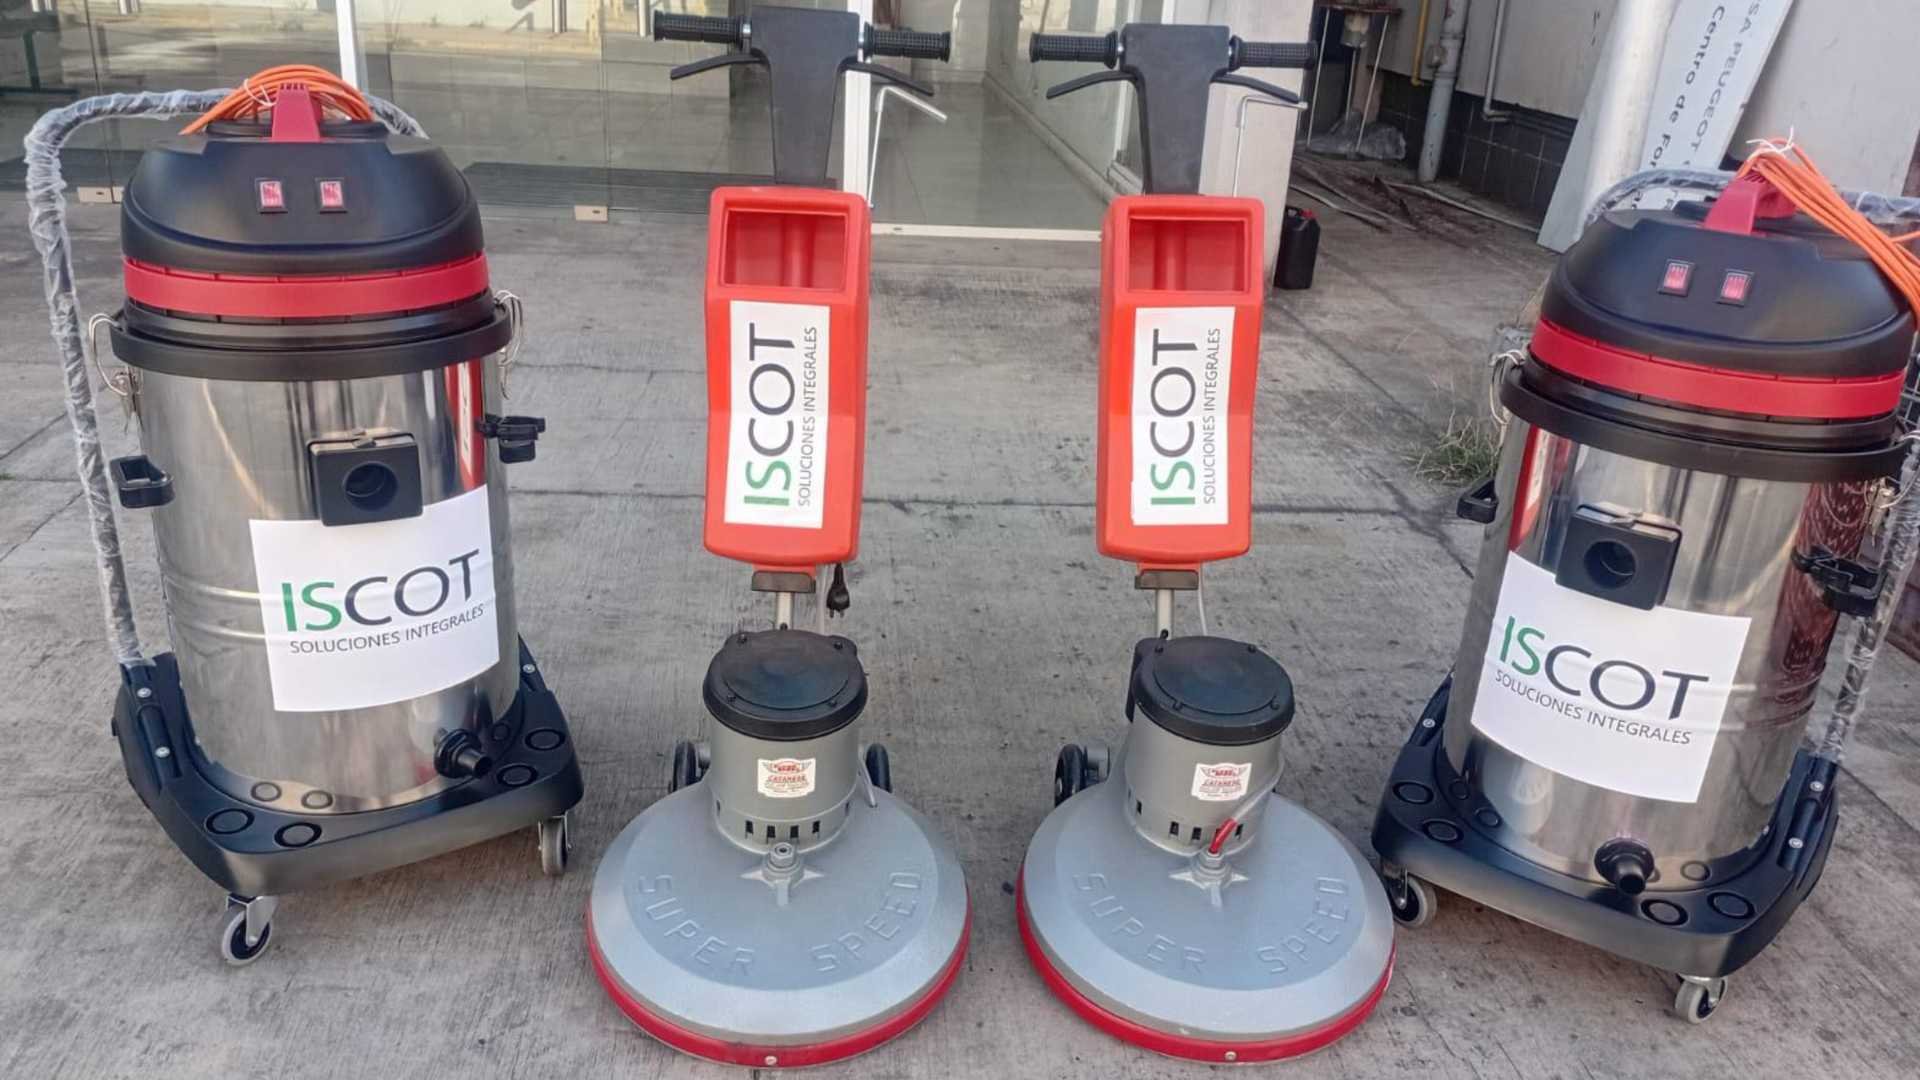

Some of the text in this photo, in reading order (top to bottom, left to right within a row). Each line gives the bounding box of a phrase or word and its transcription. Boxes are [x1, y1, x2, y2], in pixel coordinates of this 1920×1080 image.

[1685, 5, 1725, 85] Centro
[1690, 42, 1743, 152] PEUGEOT
[1669, 94, 1686, 124] de
[743, 322, 796, 506] ISCOT
[798, 326, 818, 507] SOLUCIONES INTEGRALES
[1150, 328, 1198, 505] ISCOT
[1203, 327, 1221, 504] SOLUCIONES INTEGRALES
[281, 548, 480, 632] ISCOT
[290, 603, 485, 654] SOLUCIONES INTEGRALES
[1495, 669, 1692, 745] SOLUCIONES INTEGRALES
[1499, 615, 1709, 720] ISCOT
[638, 872, 921, 976] SUPER SPEED
[1072, 873, 1349, 974] SUPER SPEED
